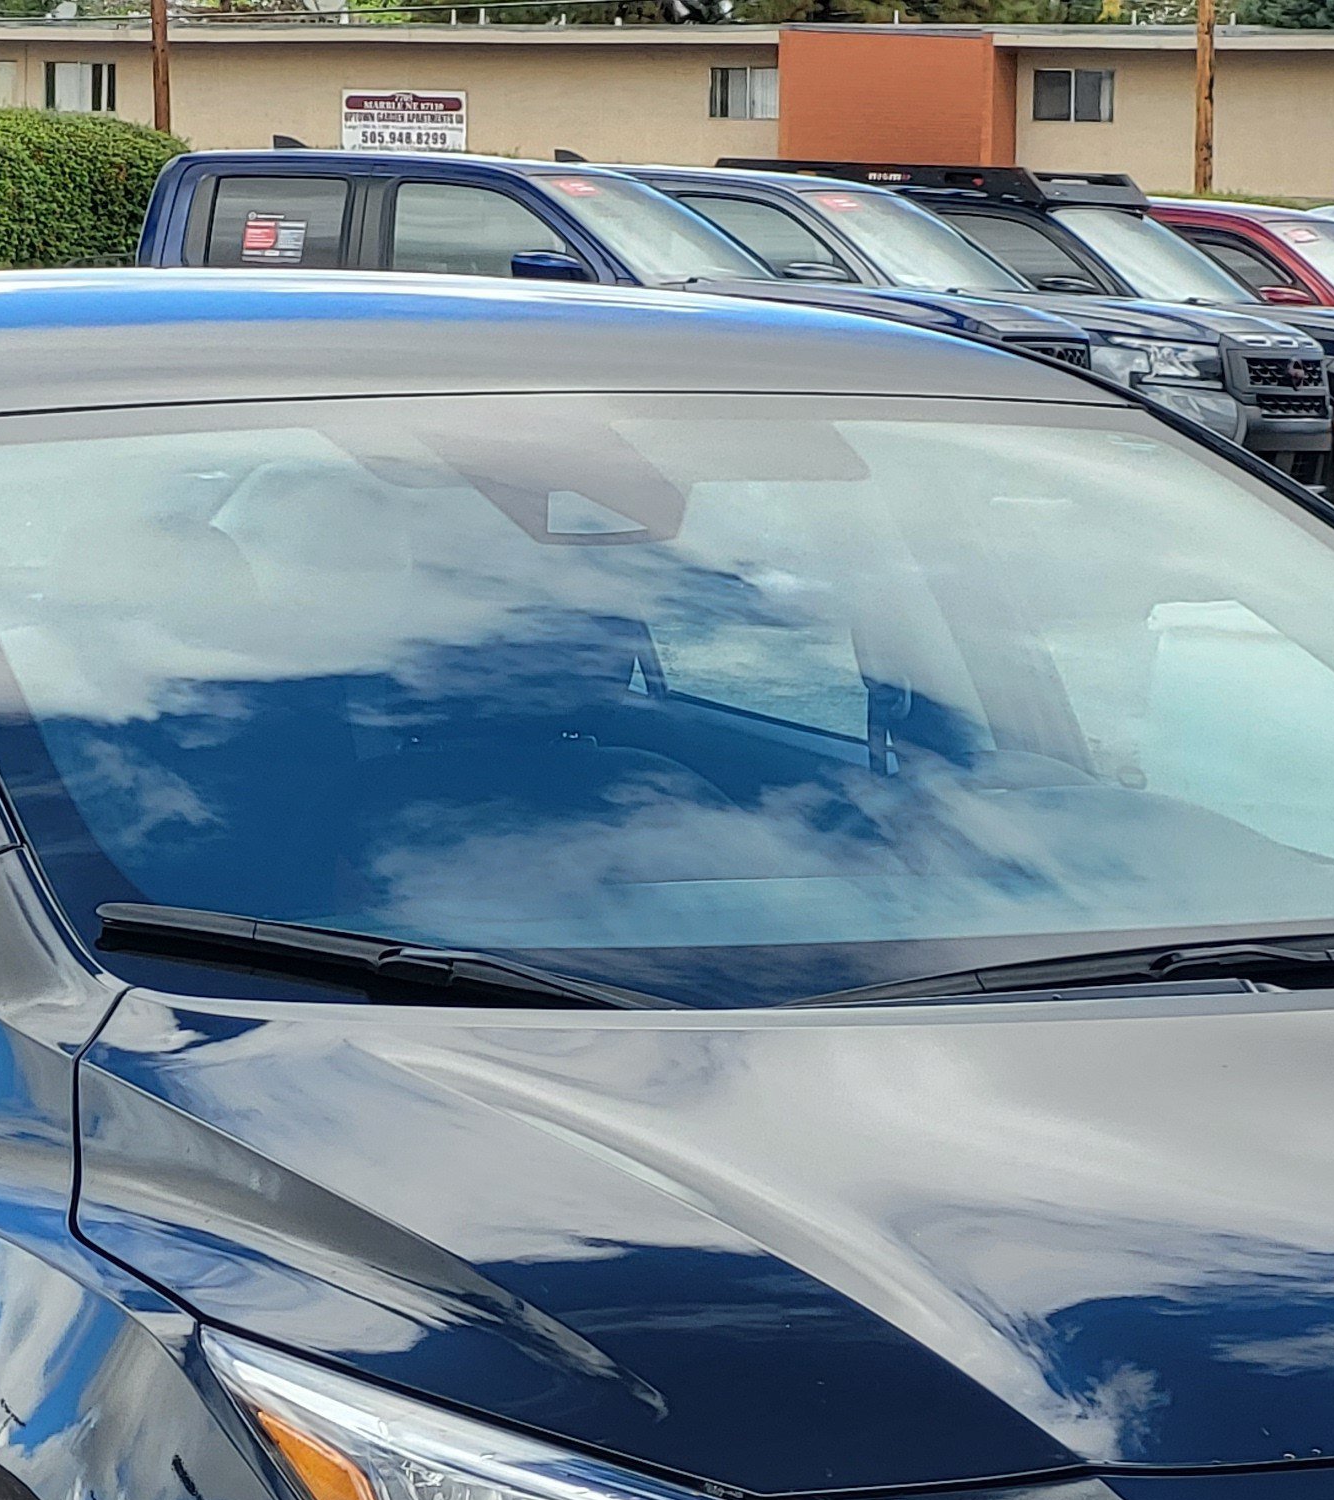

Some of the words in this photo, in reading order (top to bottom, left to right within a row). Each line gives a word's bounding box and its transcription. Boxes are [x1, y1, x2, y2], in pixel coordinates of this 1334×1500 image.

[363, 101, 402, 110] MARBLE
[406, 101, 419, 110] NE
[344, 112, 375, 122] UPTOWN
[377, 112, 405, 122] GARDEN
[407, 113, 454, 123] APARTMENTS
[361, 131, 447, 145] 505.948.8299
